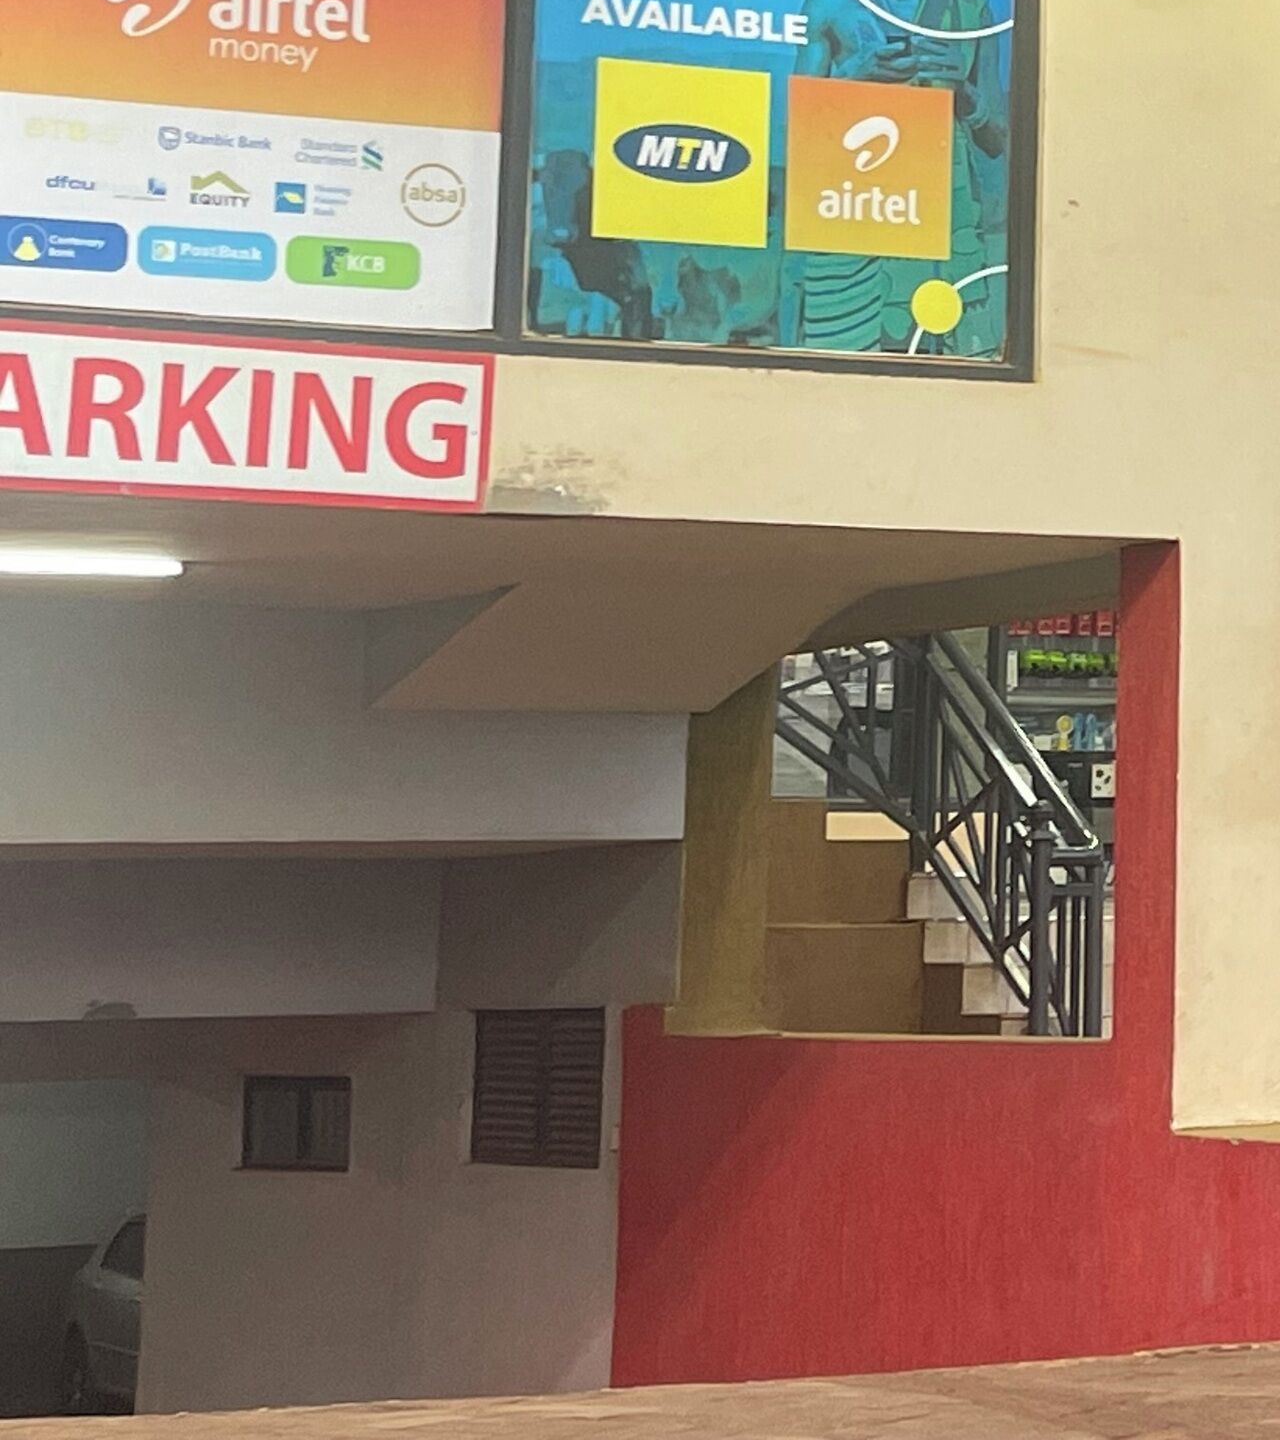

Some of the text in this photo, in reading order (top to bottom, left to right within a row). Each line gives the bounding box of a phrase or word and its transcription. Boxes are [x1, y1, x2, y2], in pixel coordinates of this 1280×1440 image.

[208, 37, 318, 73] money
[637, 134, 728, 172] MTN
[189, 192, 250, 209] EQUITY
[408, 181, 459, 204] absa
[818, 181, 921, 226] airtel
[347, 254, 386, 274] KCB
